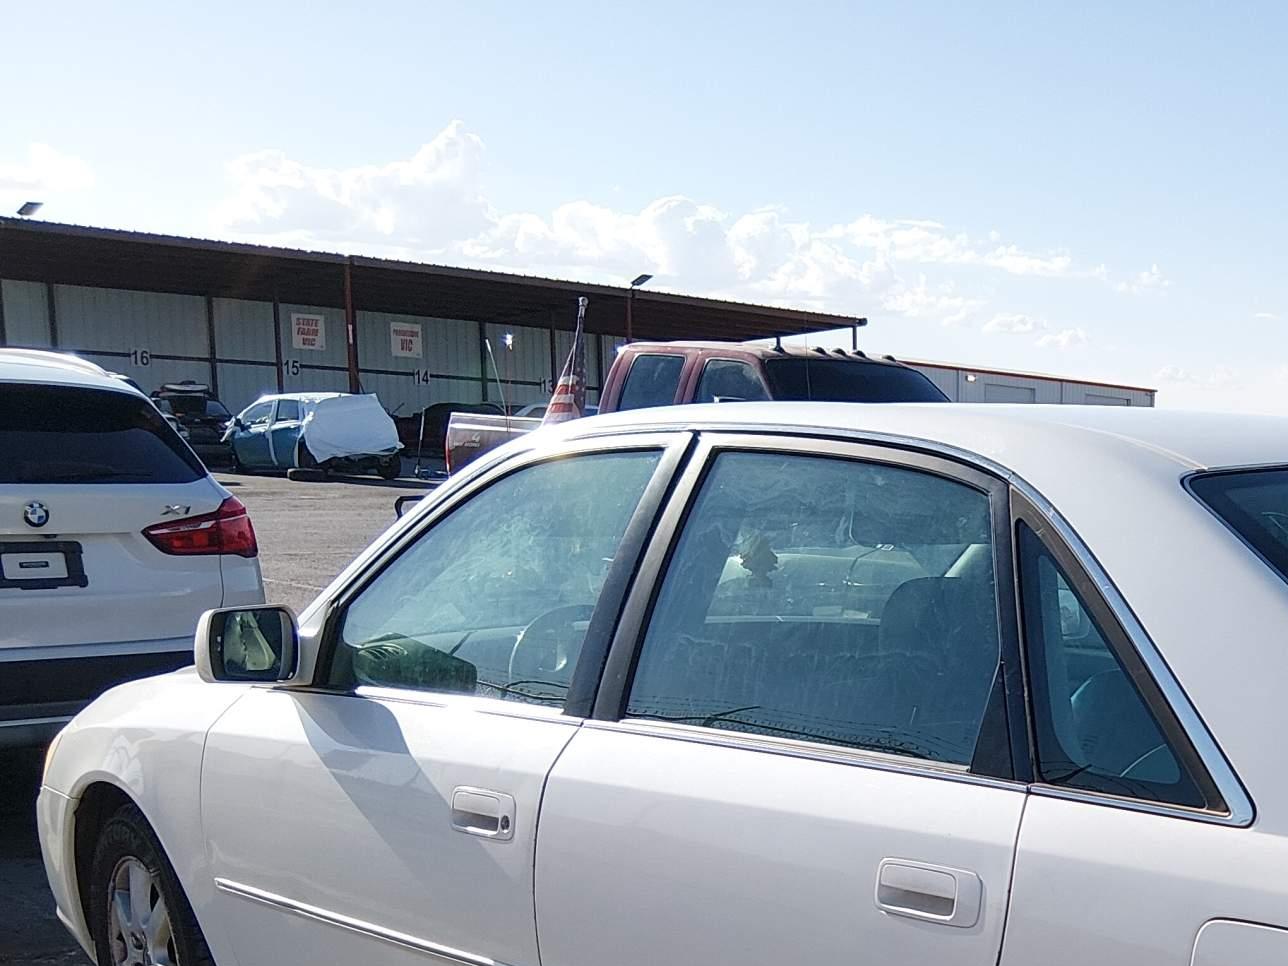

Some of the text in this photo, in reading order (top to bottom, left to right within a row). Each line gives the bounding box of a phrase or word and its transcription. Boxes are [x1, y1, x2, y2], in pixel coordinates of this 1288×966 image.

[401, 338, 413, 352] VIC
[131, 349, 149, 366] 16
[284, 360, 300, 376] 15
[416, 369, 430, 385] 14
[161, 504, 191, 515] X1
